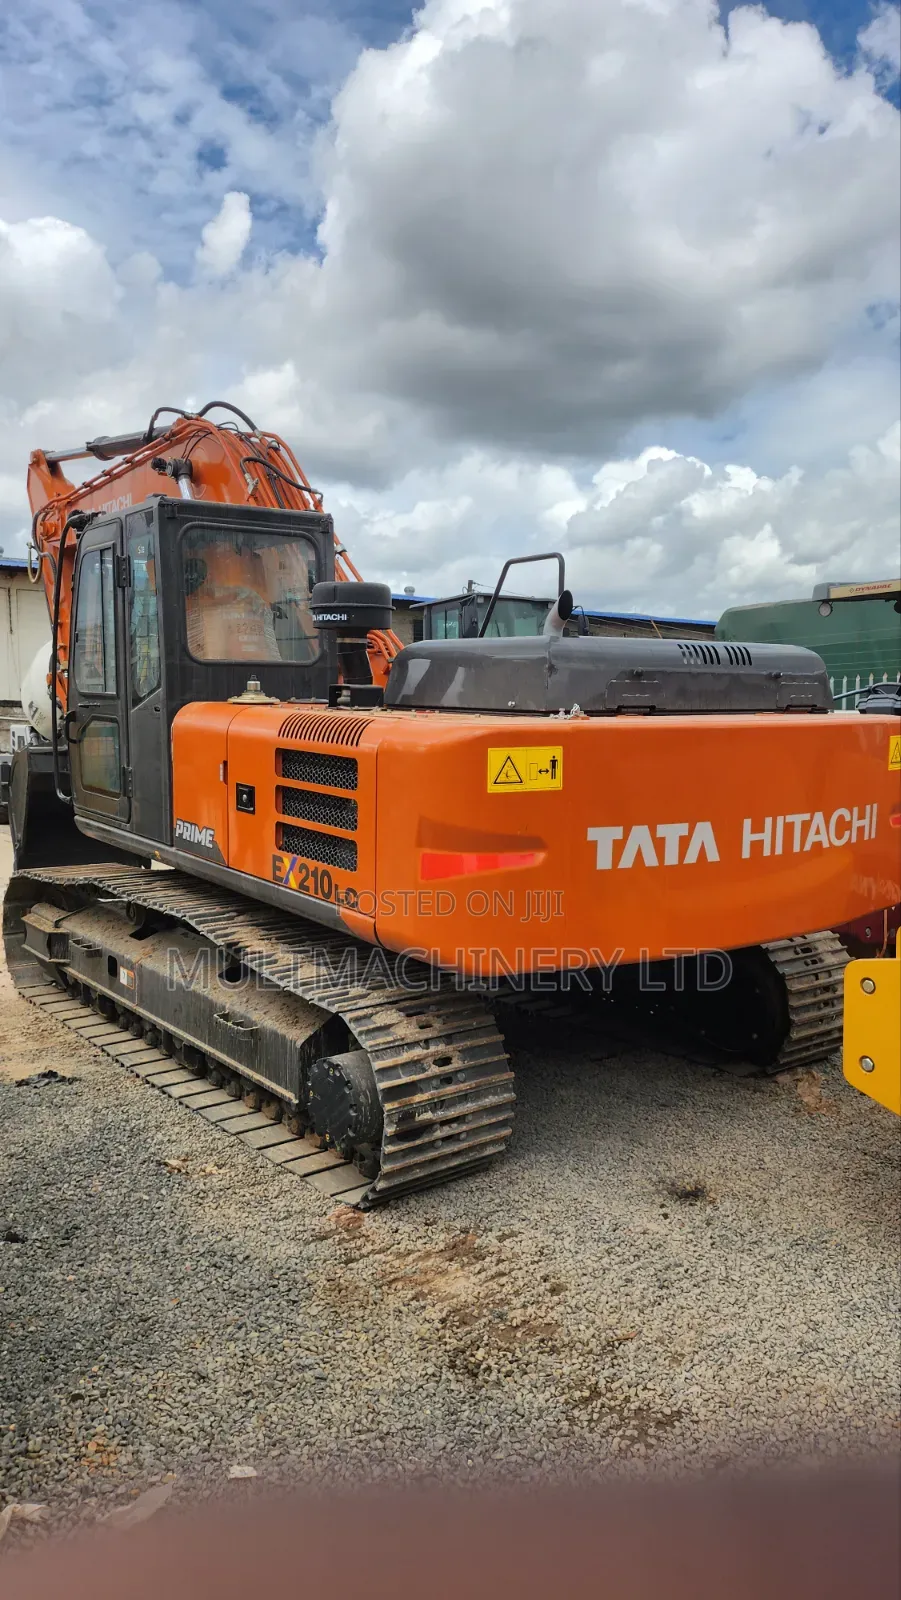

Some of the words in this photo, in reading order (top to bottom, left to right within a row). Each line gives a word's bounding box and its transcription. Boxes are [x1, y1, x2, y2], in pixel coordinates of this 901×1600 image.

[316, 613, 347, 621] HITACHI
[175, 819, 215, 849] PRIME
[587, 821, 720, 870] TATA
[742, 803, 878, 858] HITACHI
